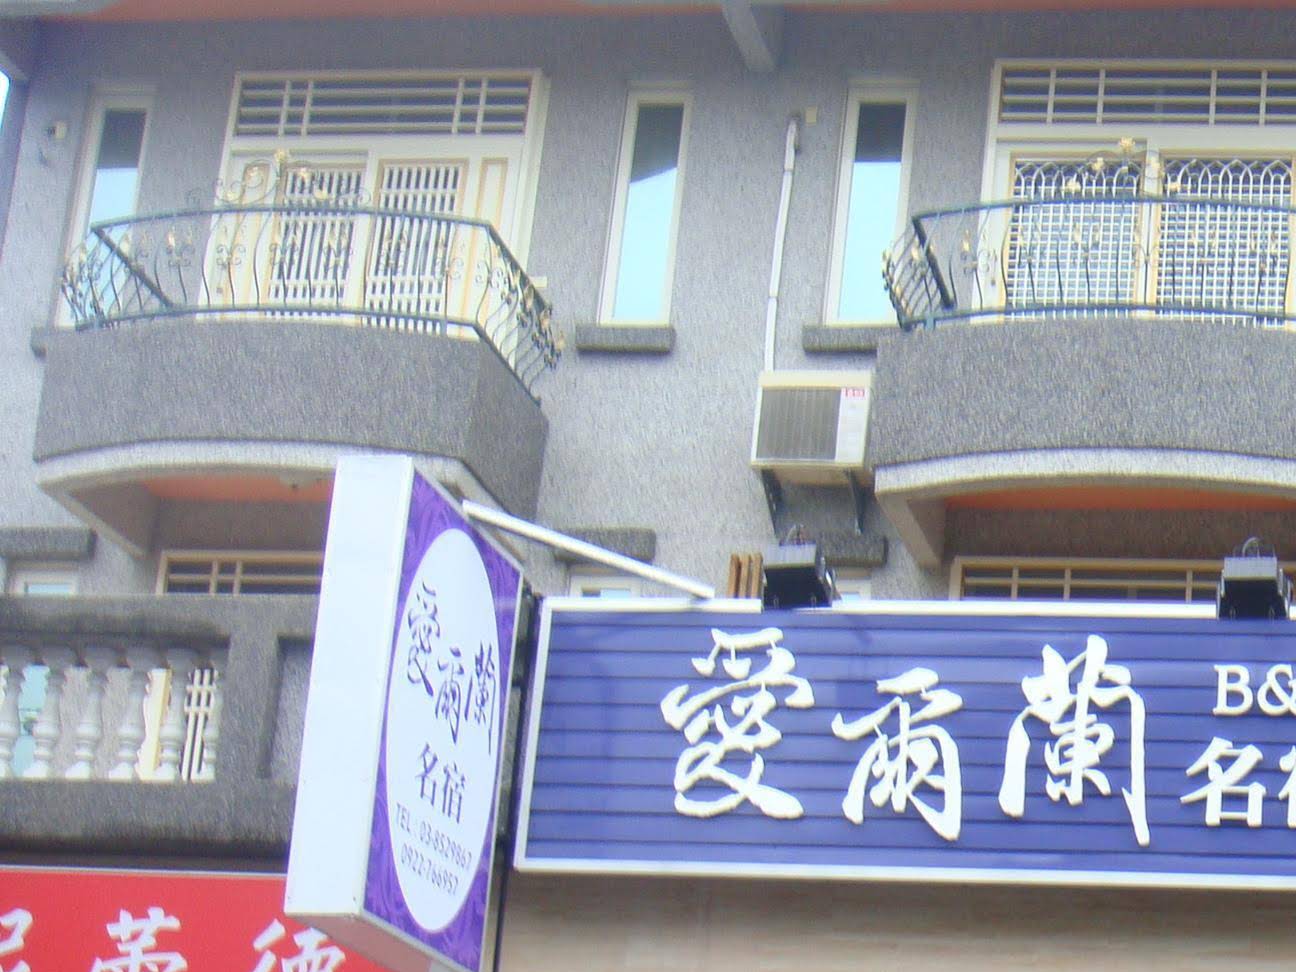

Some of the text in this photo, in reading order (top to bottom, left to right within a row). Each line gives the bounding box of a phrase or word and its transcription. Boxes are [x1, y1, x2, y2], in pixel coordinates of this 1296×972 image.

[407, 580, 497, 756] 愛爾蘭
[660, 627, 1151, 847] 愛爾蘭
[415, 742, 466, 825] 名宿
